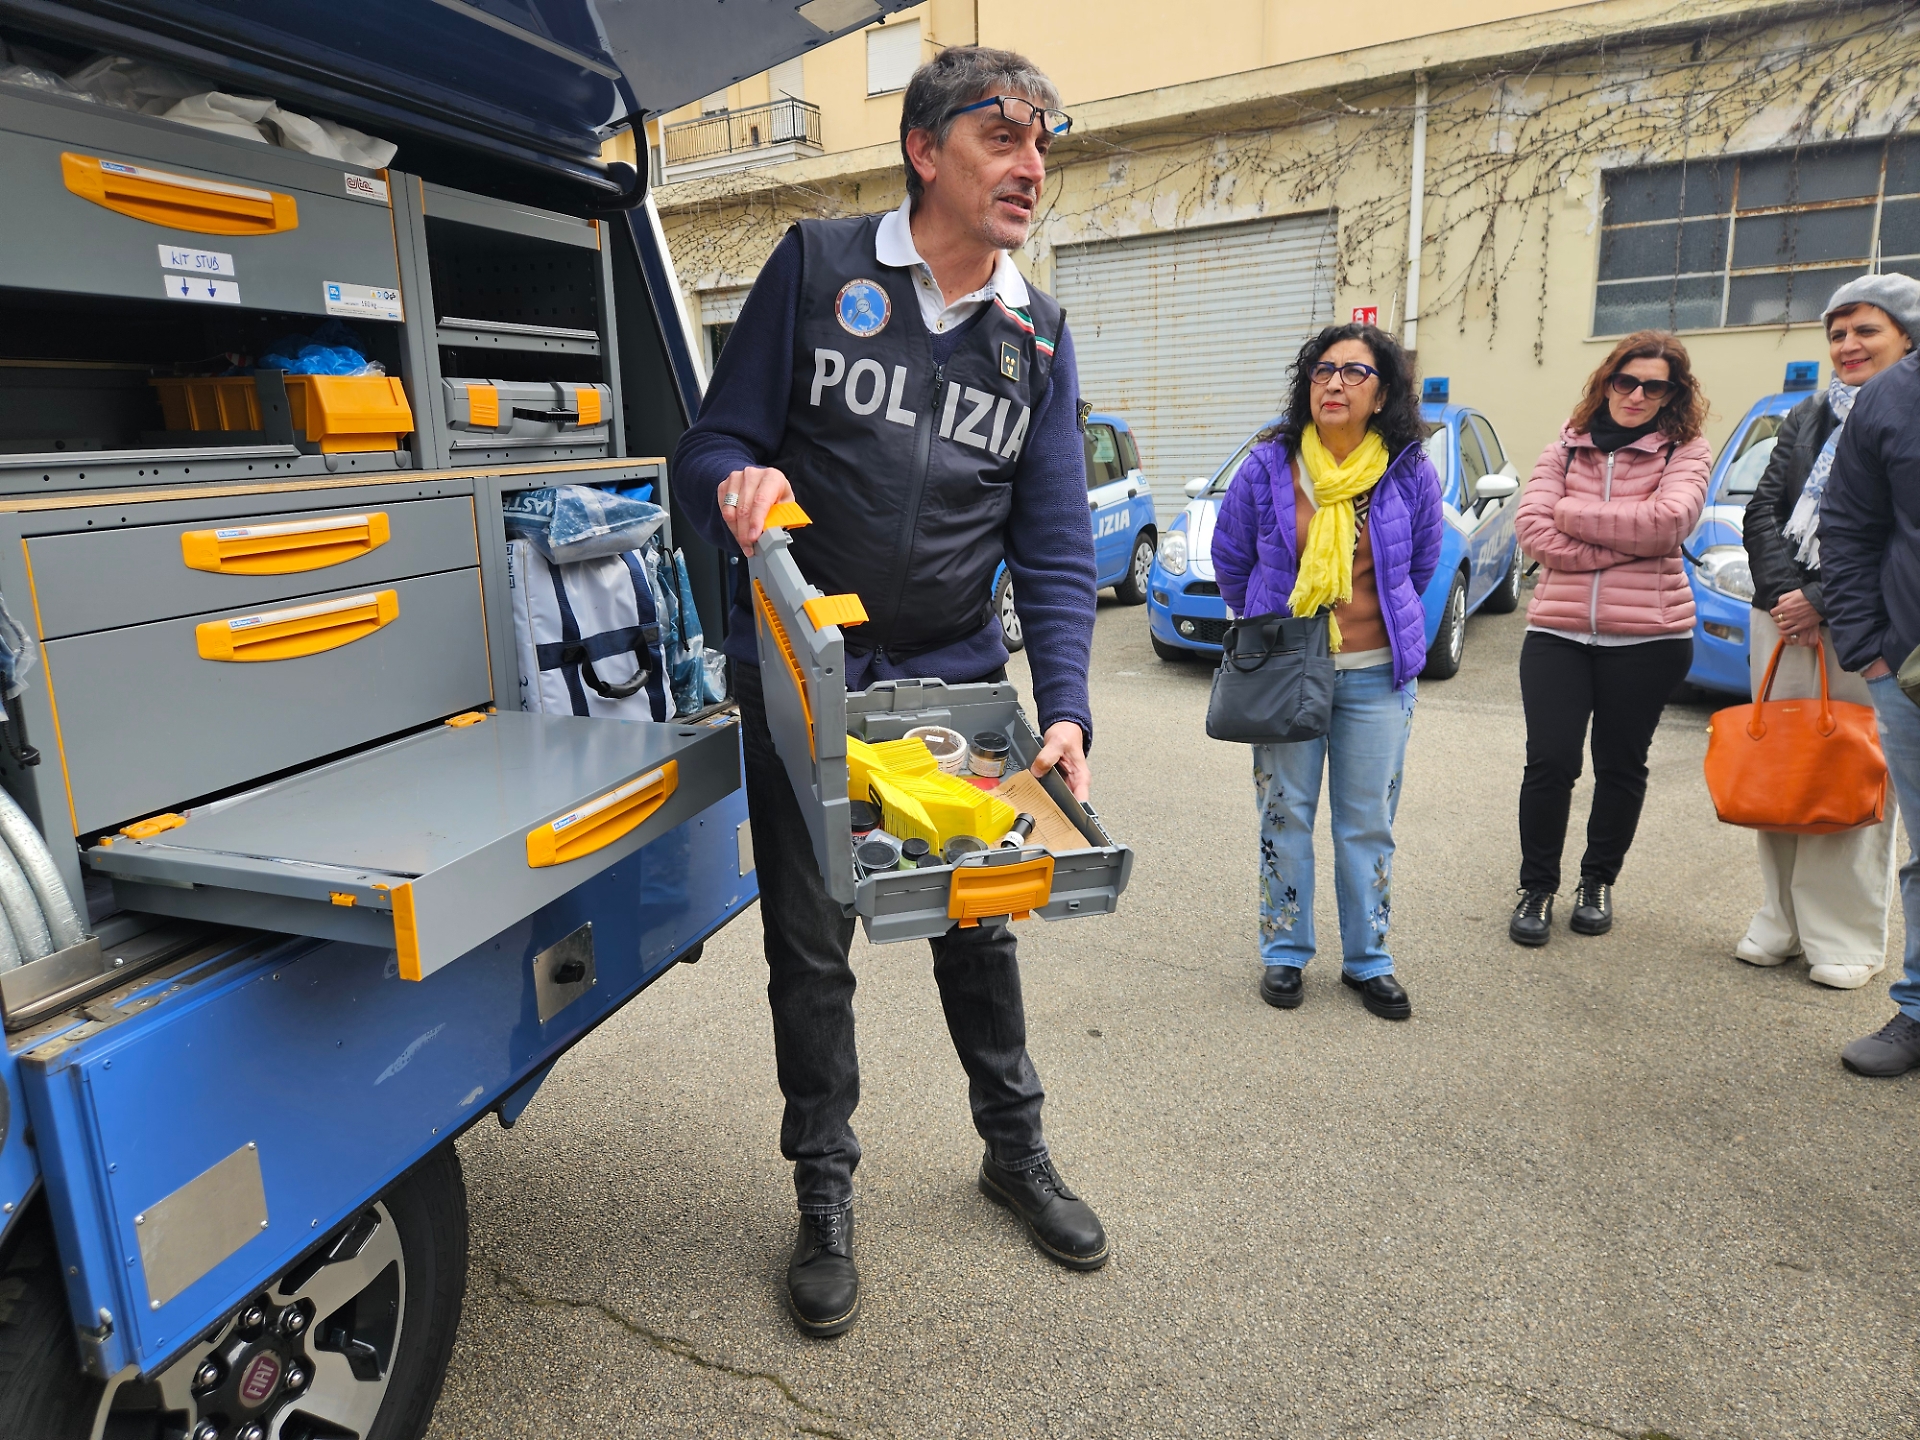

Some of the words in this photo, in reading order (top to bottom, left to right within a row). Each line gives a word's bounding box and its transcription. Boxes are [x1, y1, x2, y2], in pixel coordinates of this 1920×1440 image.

[171, 251, 189, 266] KIT
[195, 255, 220, 271] STUB
[810, 348, 1031, 462] POLIZIA
[1093, 508, 1131, 540] IZIA
[246, 1360, 275, 1397] FIAT
